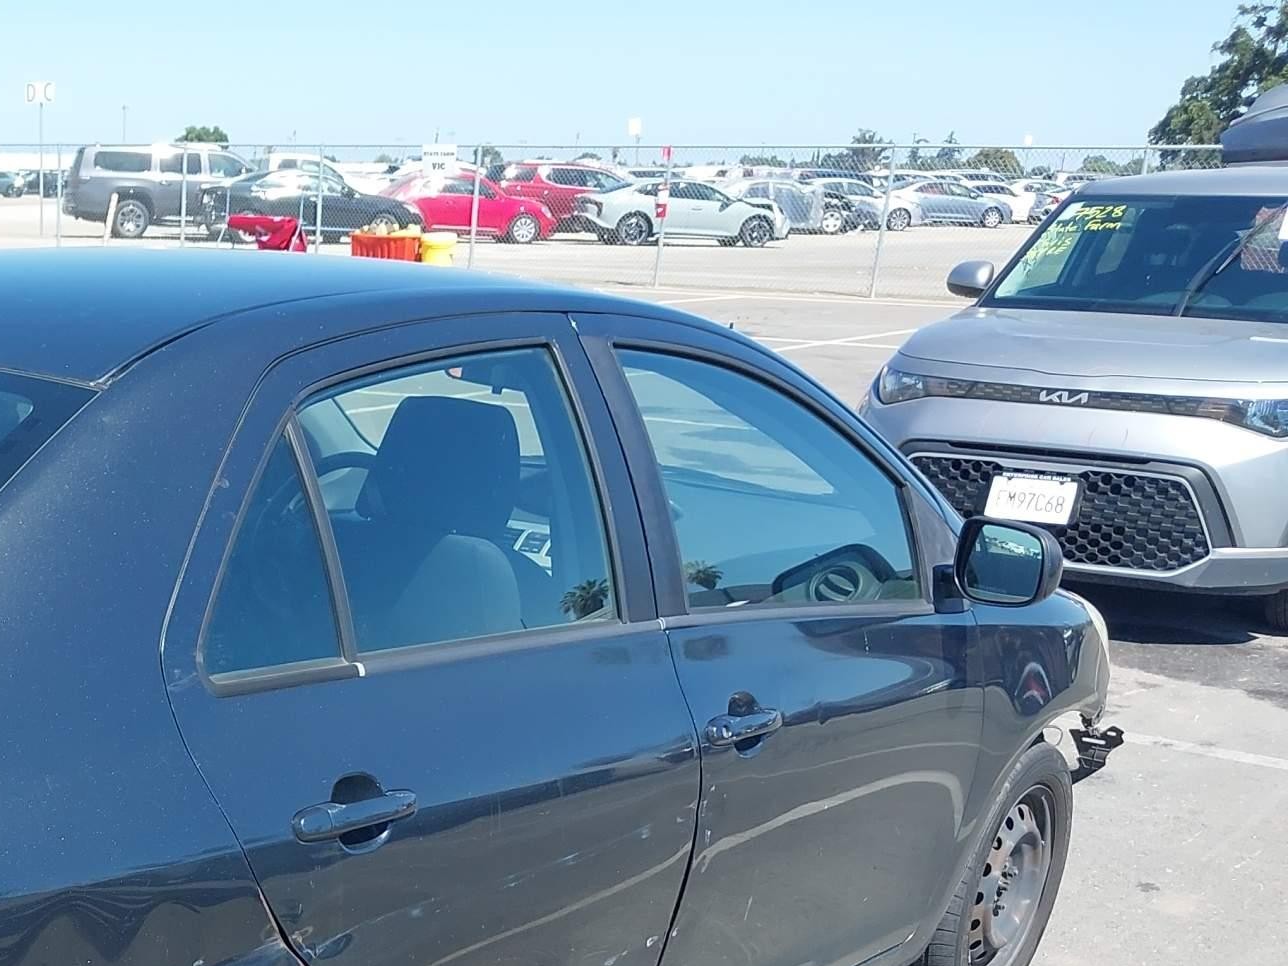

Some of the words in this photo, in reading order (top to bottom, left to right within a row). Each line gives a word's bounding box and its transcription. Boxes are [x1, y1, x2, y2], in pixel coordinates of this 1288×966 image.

[26, 83, 36, 102] D
[44, 82, 53, 102] C
[1075, 204, 1127, 221] 7528
[1083, 219, 1121, 231] Farm
